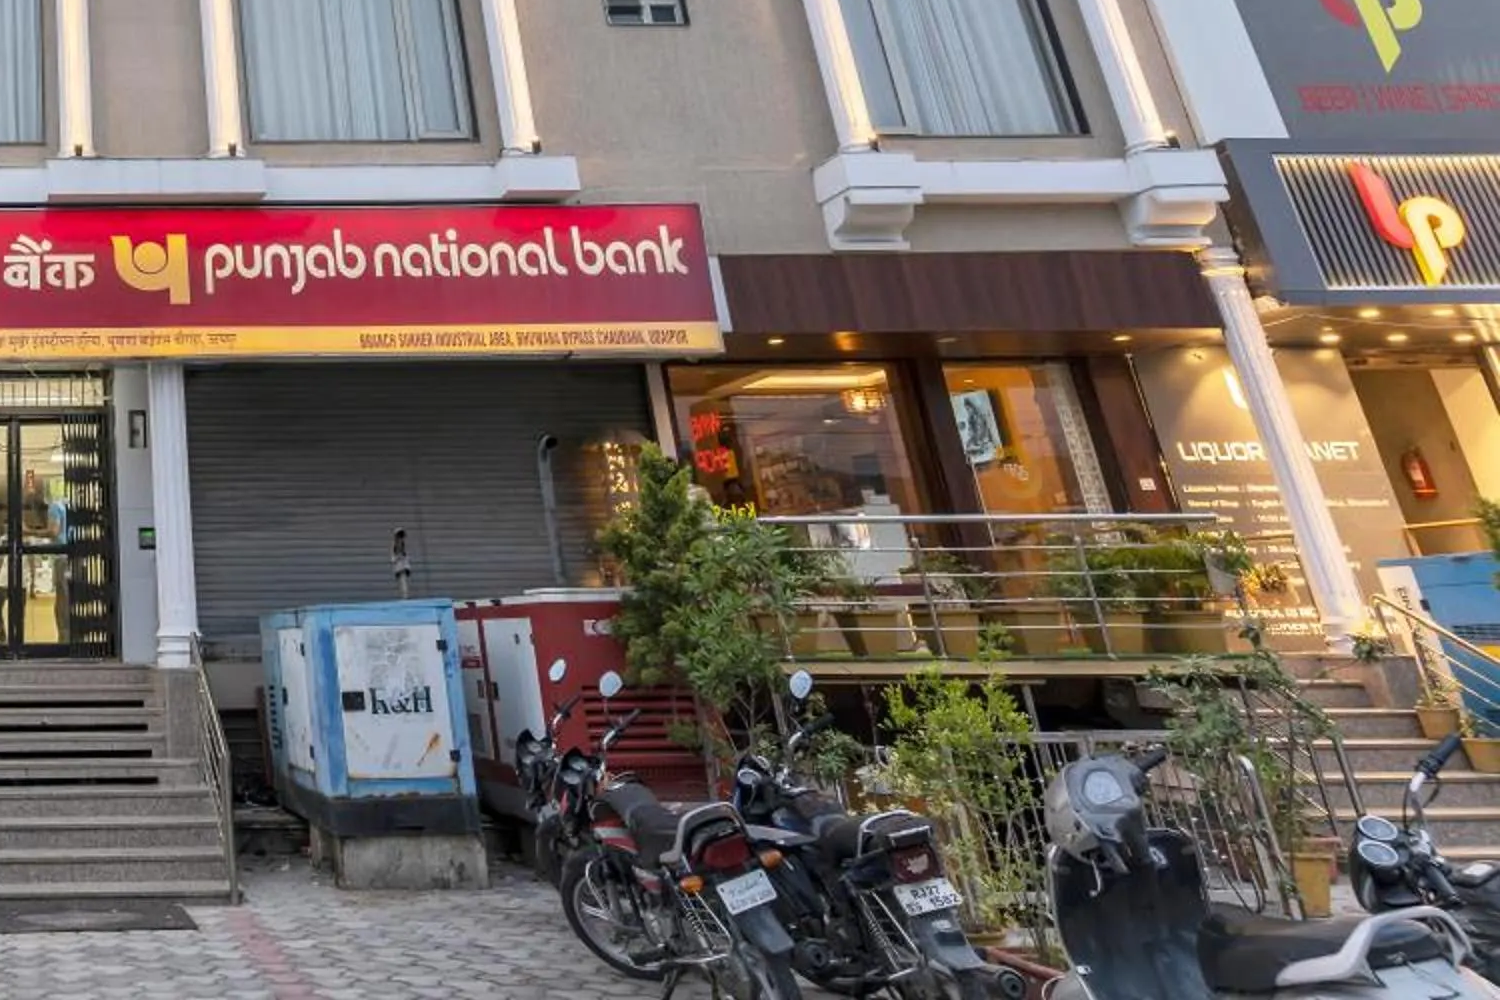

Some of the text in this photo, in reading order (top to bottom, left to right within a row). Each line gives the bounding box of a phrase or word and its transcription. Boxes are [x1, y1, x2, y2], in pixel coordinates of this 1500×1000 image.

[3, 233, 95, 291] बैंक
[205, 224, 688, 294] punjab national bank
[1177, 441, 1268, 464] LIQUOR
